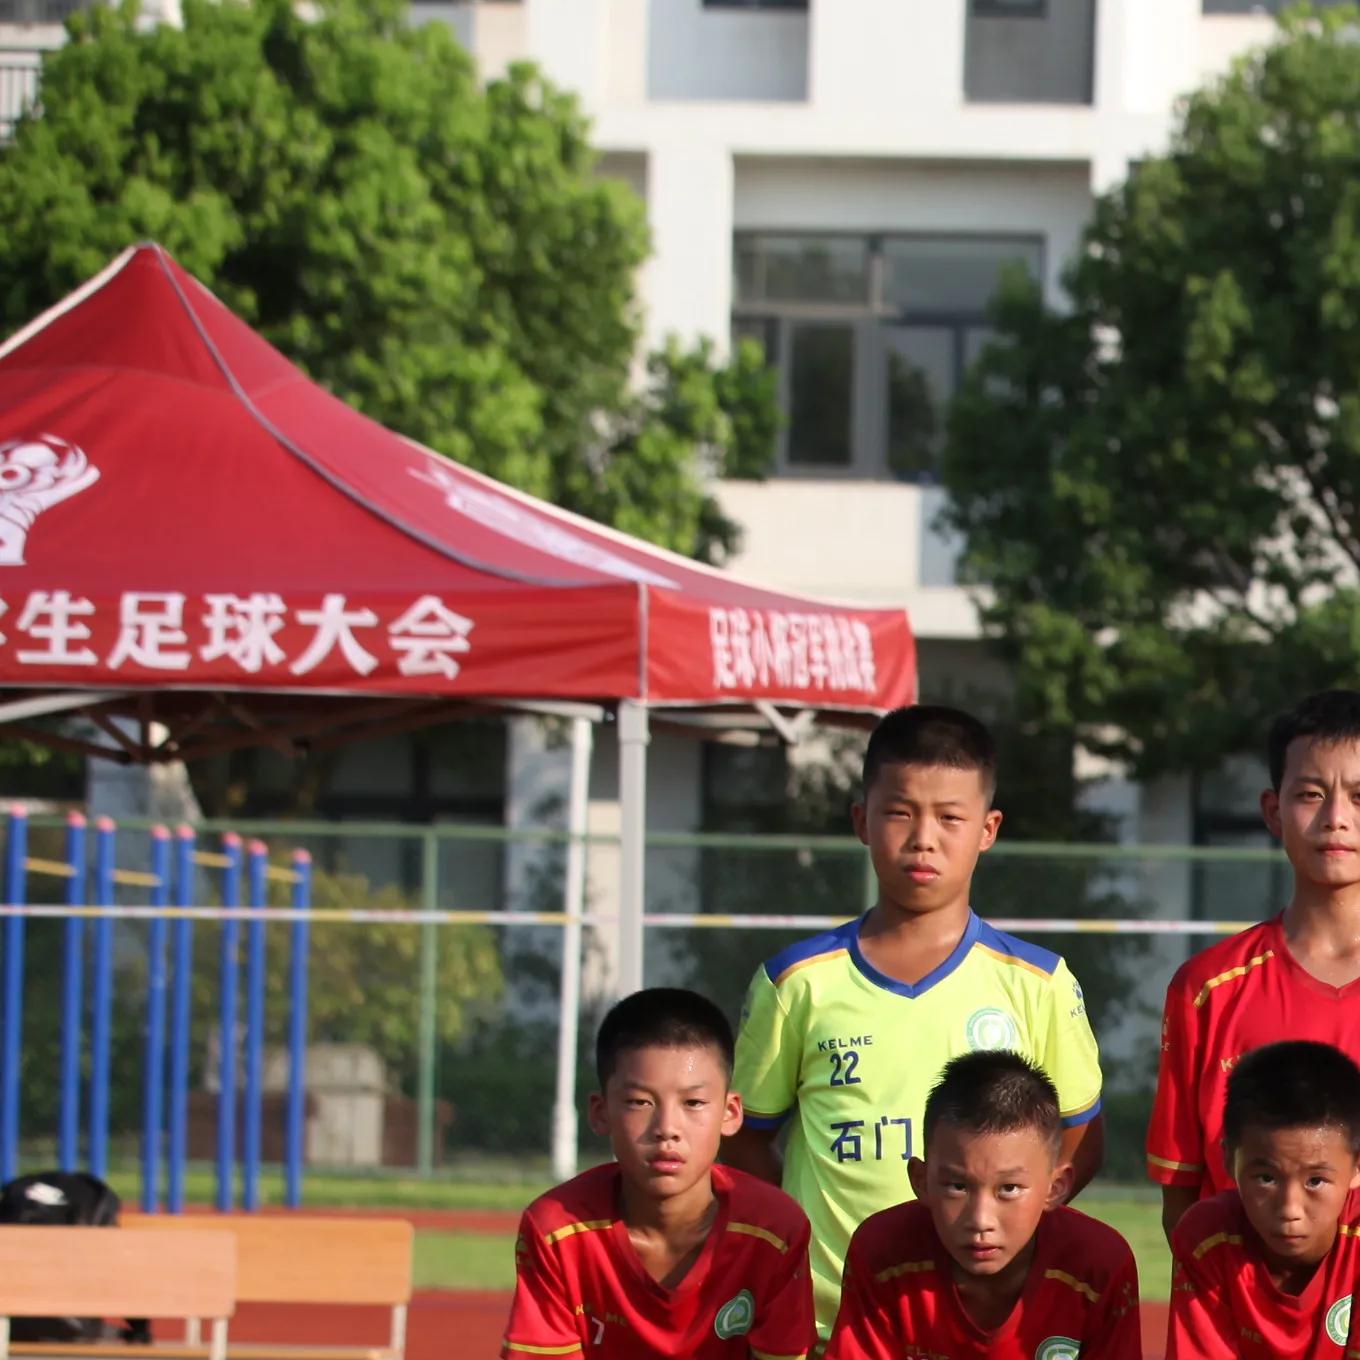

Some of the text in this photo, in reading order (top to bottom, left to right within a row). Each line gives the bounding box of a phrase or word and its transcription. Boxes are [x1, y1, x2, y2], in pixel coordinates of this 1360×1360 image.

[0, 589, 476, 680] 生足球大会
[817, 1035, 874, 1052] KELME
[829, 1050, 862, 1087] 22
[830, 1116, 913, 1162] 石门
